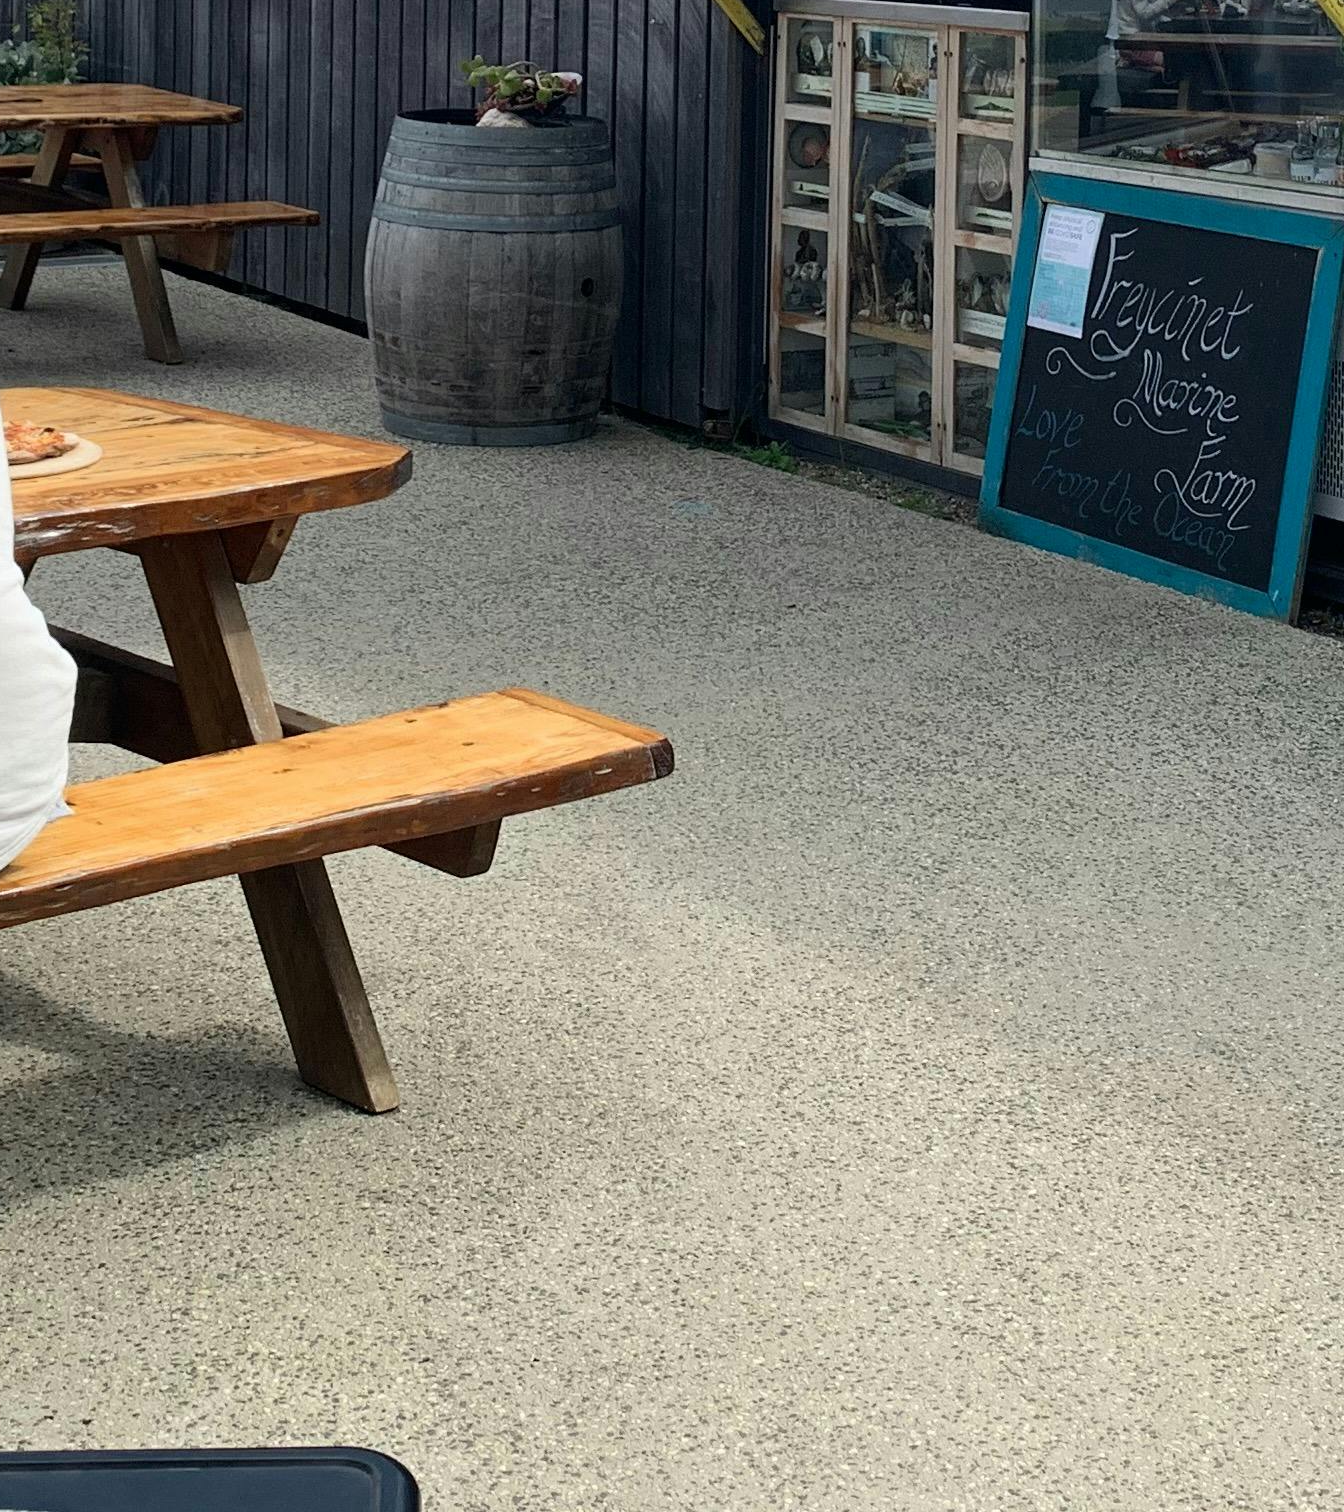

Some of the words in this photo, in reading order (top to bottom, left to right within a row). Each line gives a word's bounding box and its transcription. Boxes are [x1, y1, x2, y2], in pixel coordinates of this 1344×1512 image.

[1090, 228, 1254, 363] Freycinet
[1015, 384, 1085, 449] Love
[1132, 348, 1240, 437] Marine
[1155, 436, 1257, 530] Farm
